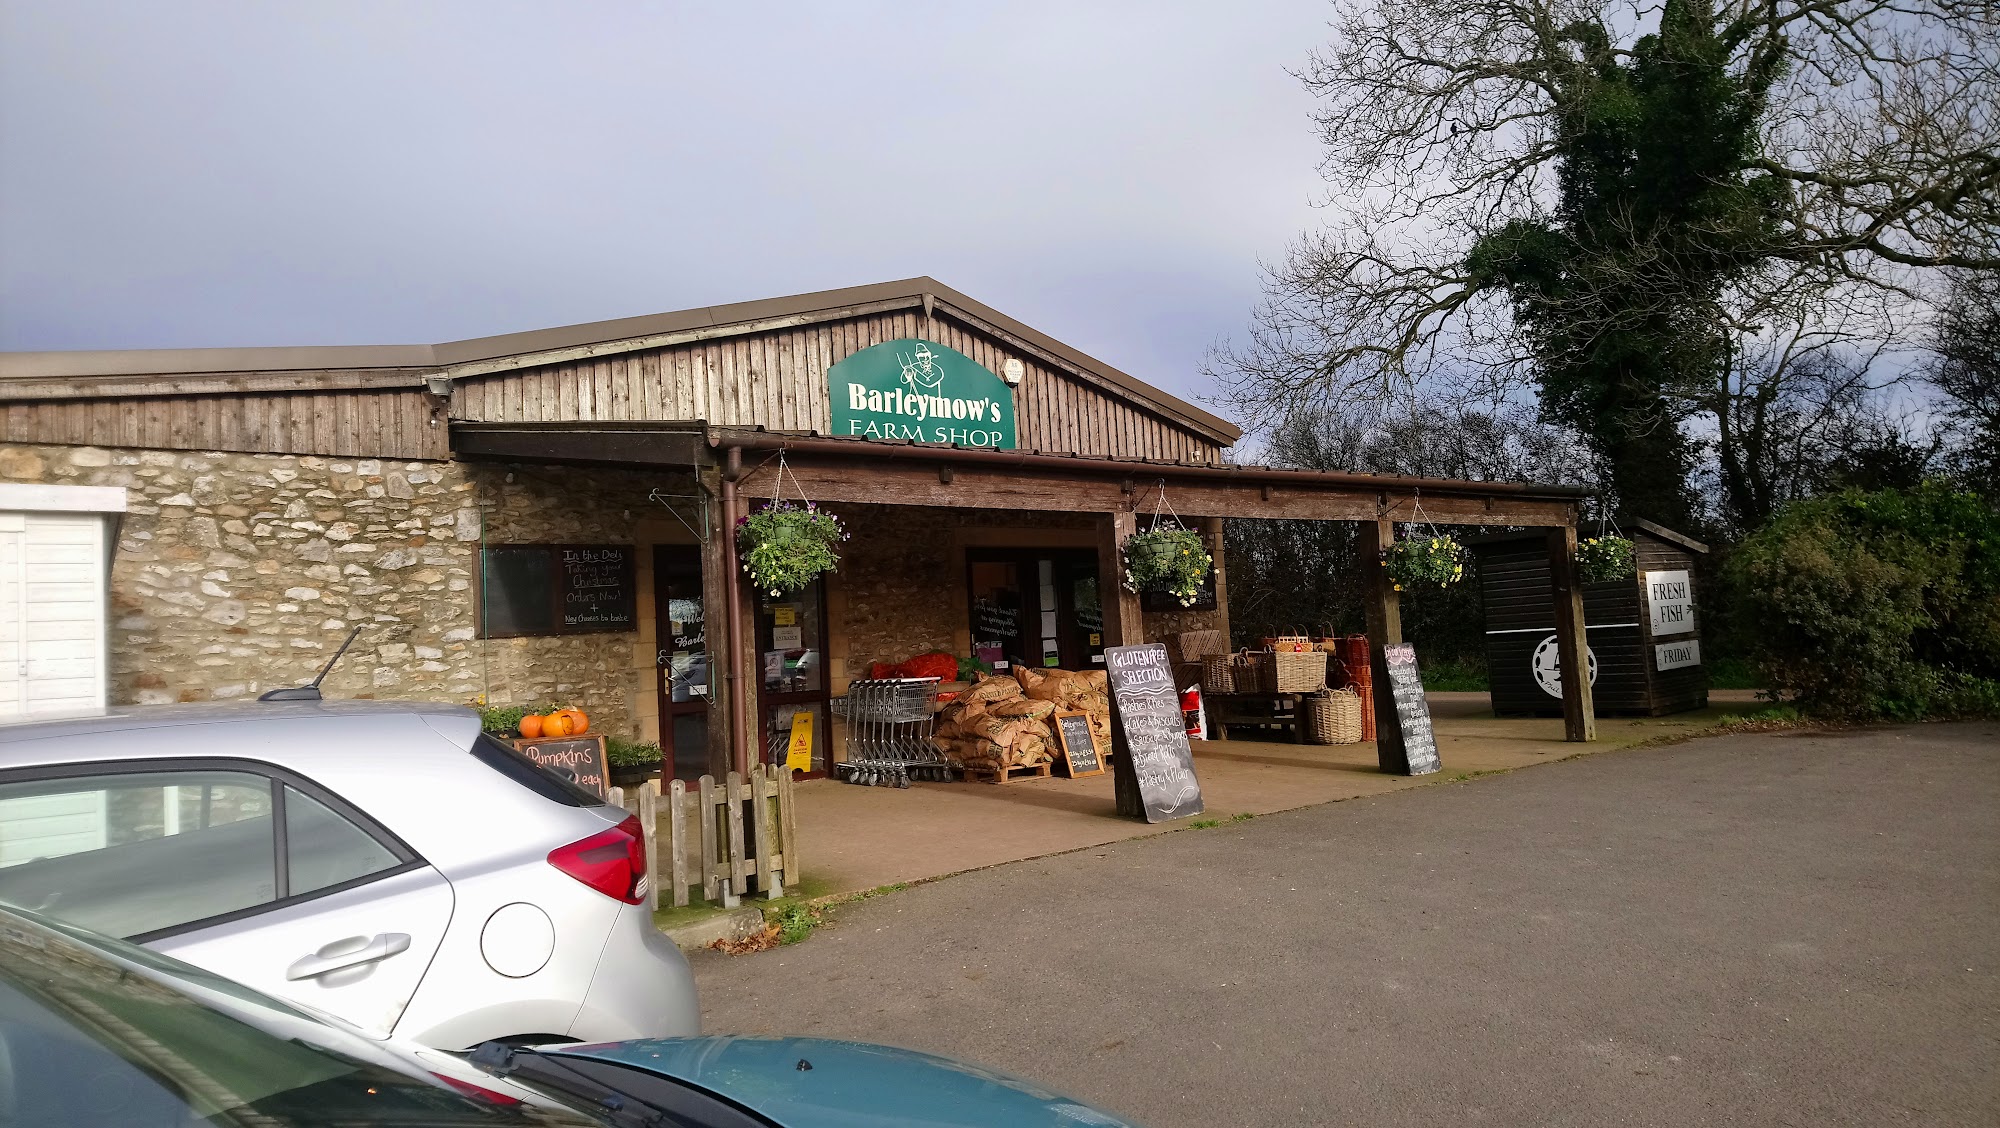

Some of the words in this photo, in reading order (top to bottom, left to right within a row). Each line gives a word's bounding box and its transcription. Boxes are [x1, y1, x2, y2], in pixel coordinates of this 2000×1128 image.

[848, 382, 1001, 422] Barleymow's
[848, 418, 926, 443] FARM
[934, 426, 1003, 447] SHOP
[563, 550, 580, 561] In
[582, 549, 599, 560] the
[601, 549, 623, 560] Deli
[565, 563, 597, 576] Taking
[601, 563, 622, 576] your
[573, 574, 620, 587] Christmas
[1652, 582, 1686, 600] FRESH
[1660, 604, 1684, 623] FISH
[1663, 647, 1692, 664] FRIDAY
[1121, 667, 1168, 686] SELECTION
